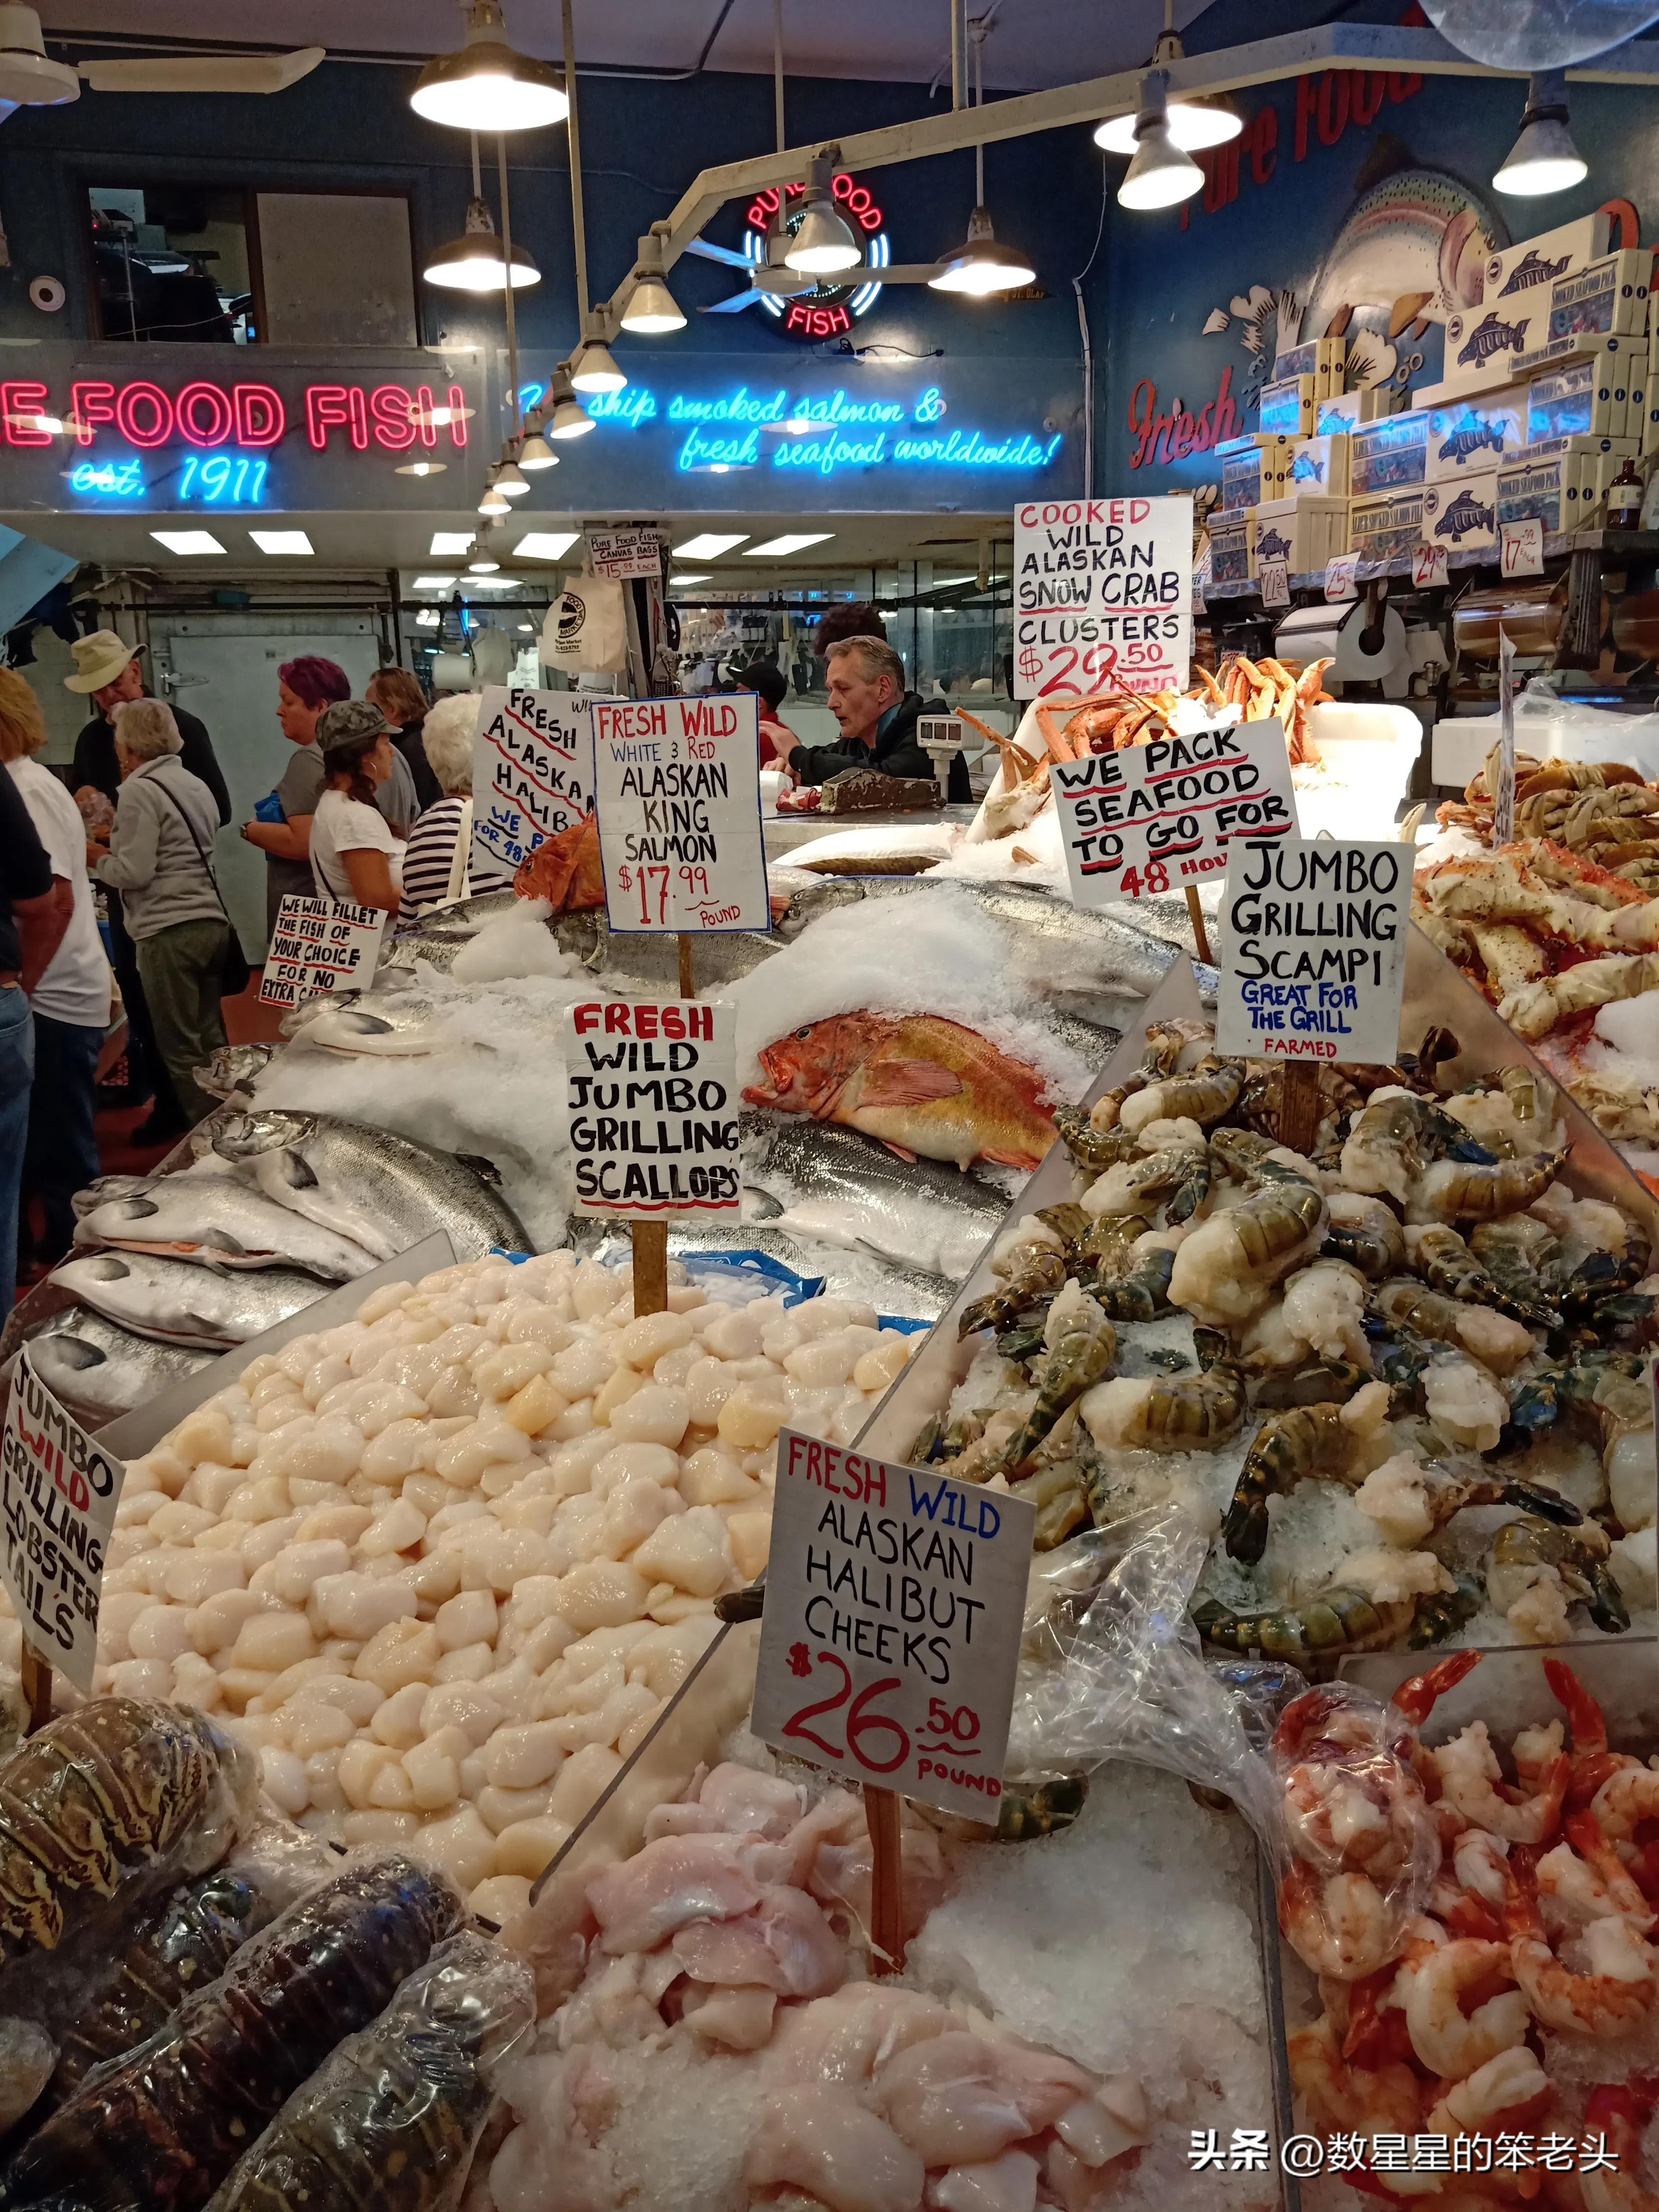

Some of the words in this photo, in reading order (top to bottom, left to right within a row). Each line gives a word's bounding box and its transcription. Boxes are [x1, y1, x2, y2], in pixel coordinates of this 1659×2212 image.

[1181, 107, 1277, 231] ure
[787, 306, 850, 335] FISH
[71, 382, 285, 447] FOOD
[306, 386, 469, 450] FISH
[587, 388, 656, 427] ship
[668, 390, 785, 422] smoked
[793, 389, 903, 423] salmon
[914, 388, 941, 422] &
[1129, 366, 1244, 469] Fresh
[677, 429, 759, 472] fresh
[773, 432, 884, 475] seafood
[893, 433, 1063, 466] worldwide!
[180, 457, 267, 502] 1911
[1020, 499, 1151, 528] COOKED
[591, 538, 611, 549] PURE
[615, 535, 637, 545] FOOD
[639, 532, 658, 542] FISH
[600, 548, 633, 559] CANVAS
[637, 546, 658, 554] BAGS
[1046, 524, 1124, 551] WILD
[1021, 541, 1154, 575] ALASKAN
[1019, 575, 1092, 609] SNOW
[1102, 572, 1179, 607] CRAB
[1018, 615, 1179, 645] CLUSTERS
[511, 689, 576, 749] FRESH
[598, 704, 667, 740] FRESH
[680, 700, 737, 736] WILD
[611, 742, 661, 762] WHITE
[687, 736, 716, 759] RED
[1057, 752, 1123, 788] WE
[1144, 728, 1241, 773] PACK
[497, 763, 575, 832] HALIB
[621, 762, 728, 798] ALASKAN
[1075, 764, 1260, 827] SEAFOOD
[474, 820, 500, 842] FOR
[492, 806, 521, 831] WE
[643, 799, 709, 833] KING
[1072, 834, 1124, 862] TO
[1146, 815, 1200, 848] GO
[1215, 795, 1289, 832] FOR
[504, 841, 522, 862] 48
[625, 834, 717, 863] SALMON
[1120, 862, 1170, 897] 48
[1243, 841, 1399, 894] JUMBO
[279, 917, 297, 932] THE
[300, 920, 326, 938] FISH
[331, 926, 350, 939] OF
[283, 898, 300, 913] WE
[302, 899, 328, 916] WILL
[332, 902, 378, 924] FILLET
[699, 905, 741, 928] POUND
[1231, 893, 1397, 941] GRILLING
[273, 937, 302, 959] YOUR
[304, 944, 361, 966] CHOICE
[1235, 939, 1381, 986] SCAMPI
[262, 979, 294, 1001] EXTRA
[277, 964, 307, 981] FOR
[313, 970, 335, 988] NO
[1241, 980, 1311, 1006] GREAT
[1319, 982, 1358, 1010] FOR
[574, 1003, 713, 1041] FRESH
[1248, 1007, 1286, 1030] THE
[1290, 1007, 1352, 1034] GRILL
[585, 1042, 699, 1072] WILD
[1264, 1038, 1337, 1058] FARMED
[568, 1077, 727, 1113] JUMBO
[570, 1117, 739, 1154] GRILLING
[15, 1353, 114, 1497] JUMBO
[18, 1405, 90, 1512] WILD
[3, 1423, 103, 1574] GRILLING
[788, 1437, 886, 1507] FRESH
[909, 1474, 1000, 1539] WILD
[3, 1470, 100, 1634] LOBSTER
[818, 1500, 973, 1586] ALASKAN
[806, 1545, 986, 1644] HALIBUT
[805, 1596, 951, 1685] CHEEKS
[917, 1759, 1001, 1798] POUND
